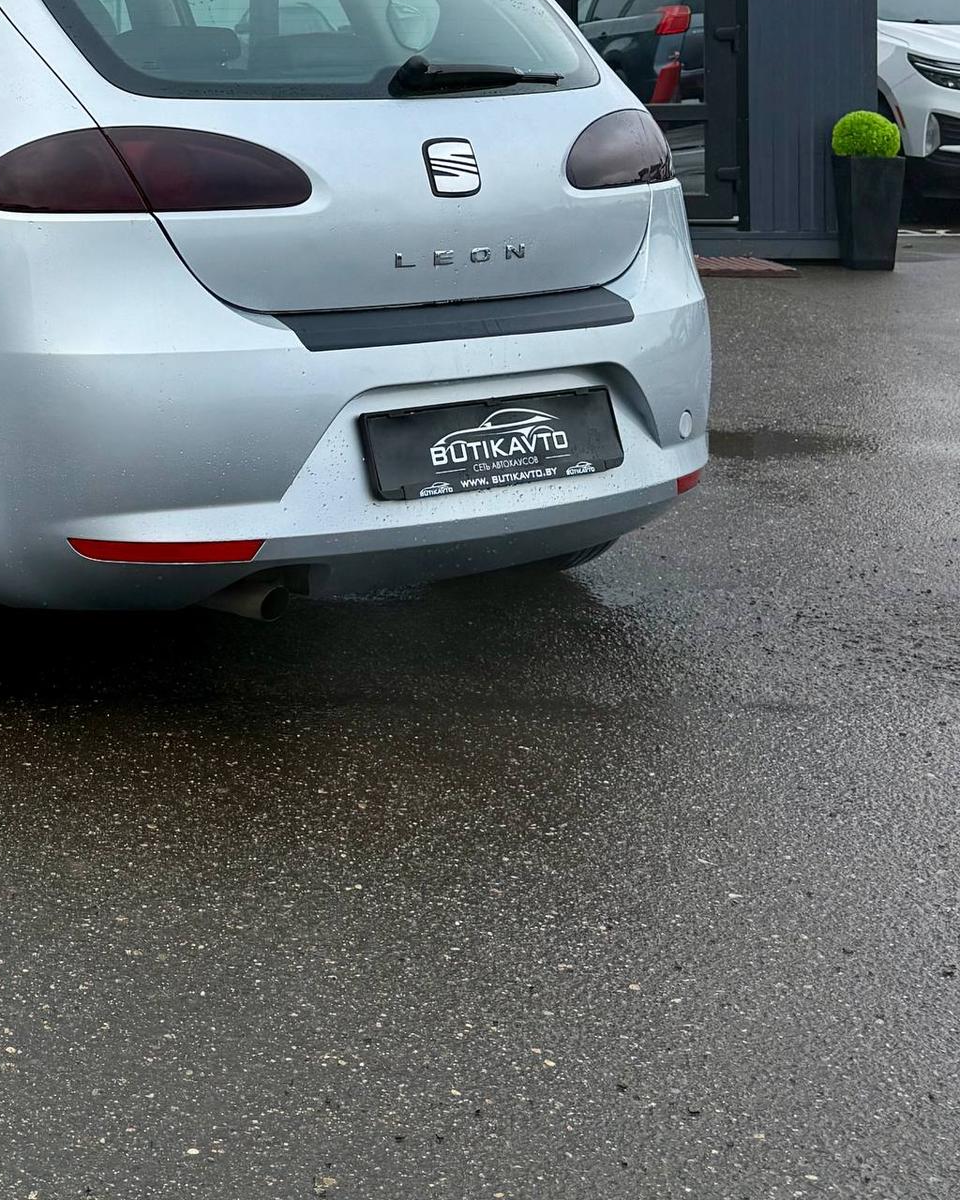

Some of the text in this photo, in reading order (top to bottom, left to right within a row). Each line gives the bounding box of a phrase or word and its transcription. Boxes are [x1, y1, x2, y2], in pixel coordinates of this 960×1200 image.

[394, 243, 526, 269] LEON
[429, 430, 569, 466] BUTIKAVTO
[473, 456, 539, 472] СЕТЬ АВТОХАУСОВ
[492, 467, 558, 484] BUTIKAVTO.BY
